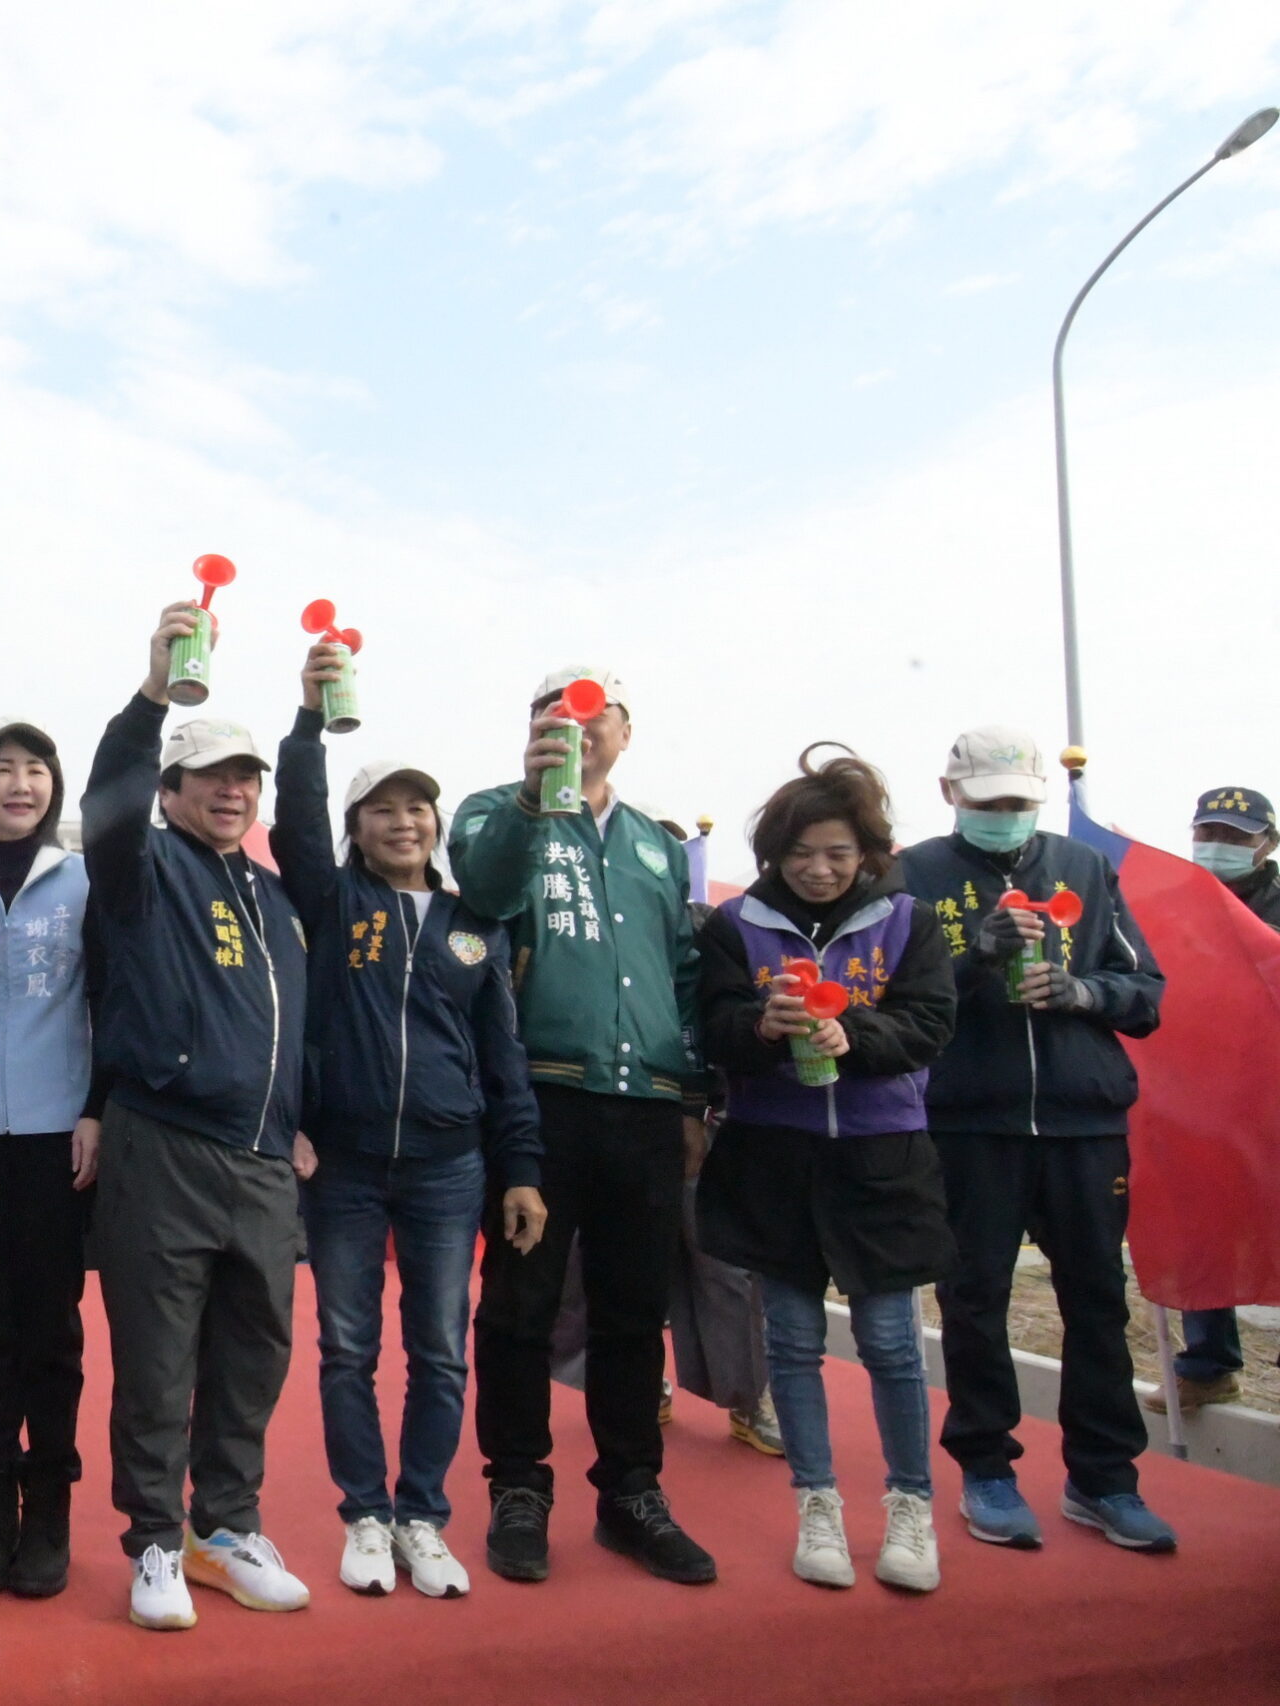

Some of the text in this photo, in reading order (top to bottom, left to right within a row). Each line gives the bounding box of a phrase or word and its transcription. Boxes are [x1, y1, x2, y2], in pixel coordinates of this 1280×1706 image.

[543, 841, 577, 938] 洪騰明
[566, 845, 600, 942] 彰化縣議員
[963, 880, 979, 910] 主席
[24, 916, 52, 998] 謝衣鳳
[211, 900, 234, 967] 張國棟
